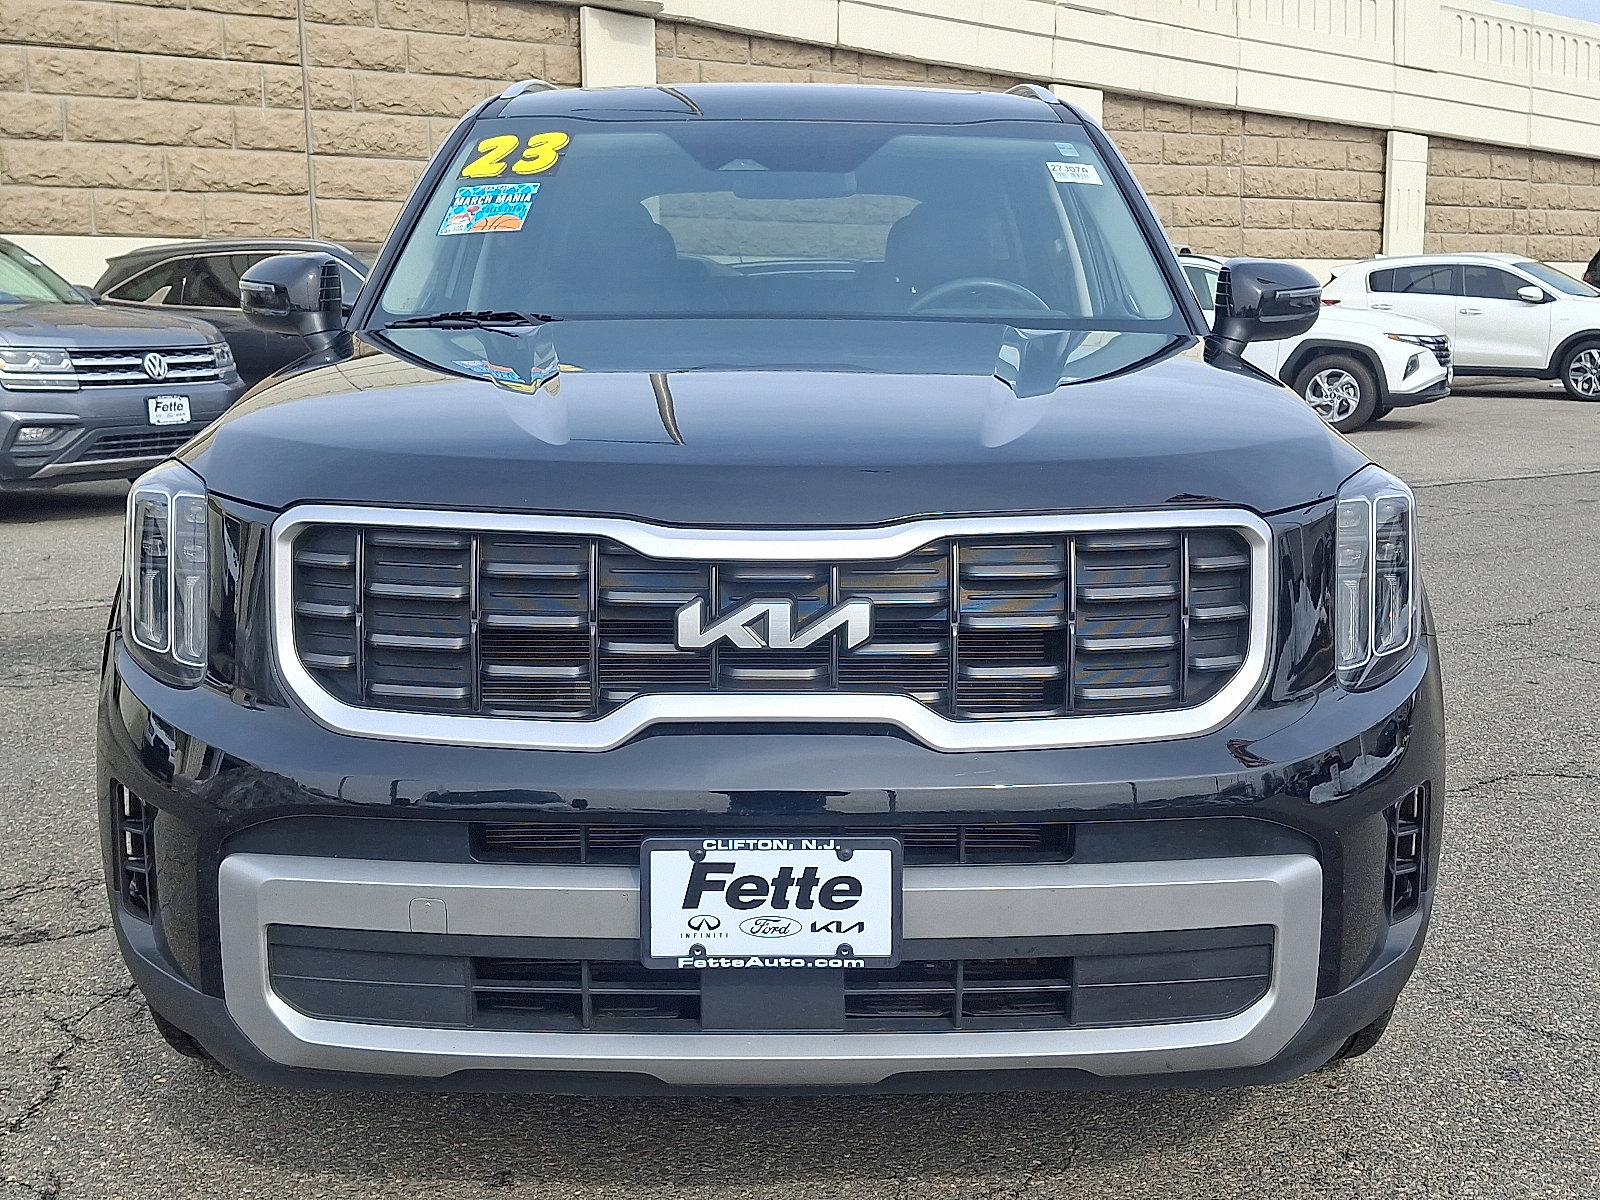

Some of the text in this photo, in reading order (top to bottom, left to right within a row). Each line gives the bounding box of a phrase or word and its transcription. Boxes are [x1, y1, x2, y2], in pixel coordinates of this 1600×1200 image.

[461, 132, 570, 178] 23
[453, 193, 532, 207] MARCH MANIA
[678, 599, 871, 649] KIA
[702, 839, 841, 851] CLIFTON, N.J.
[682, 862, 863, 911] Fette
[750, 918, 792, 935] Ford
[811, 921, 865, 933] KIA
[677, 956, 865, 969] FetteAuto.com
